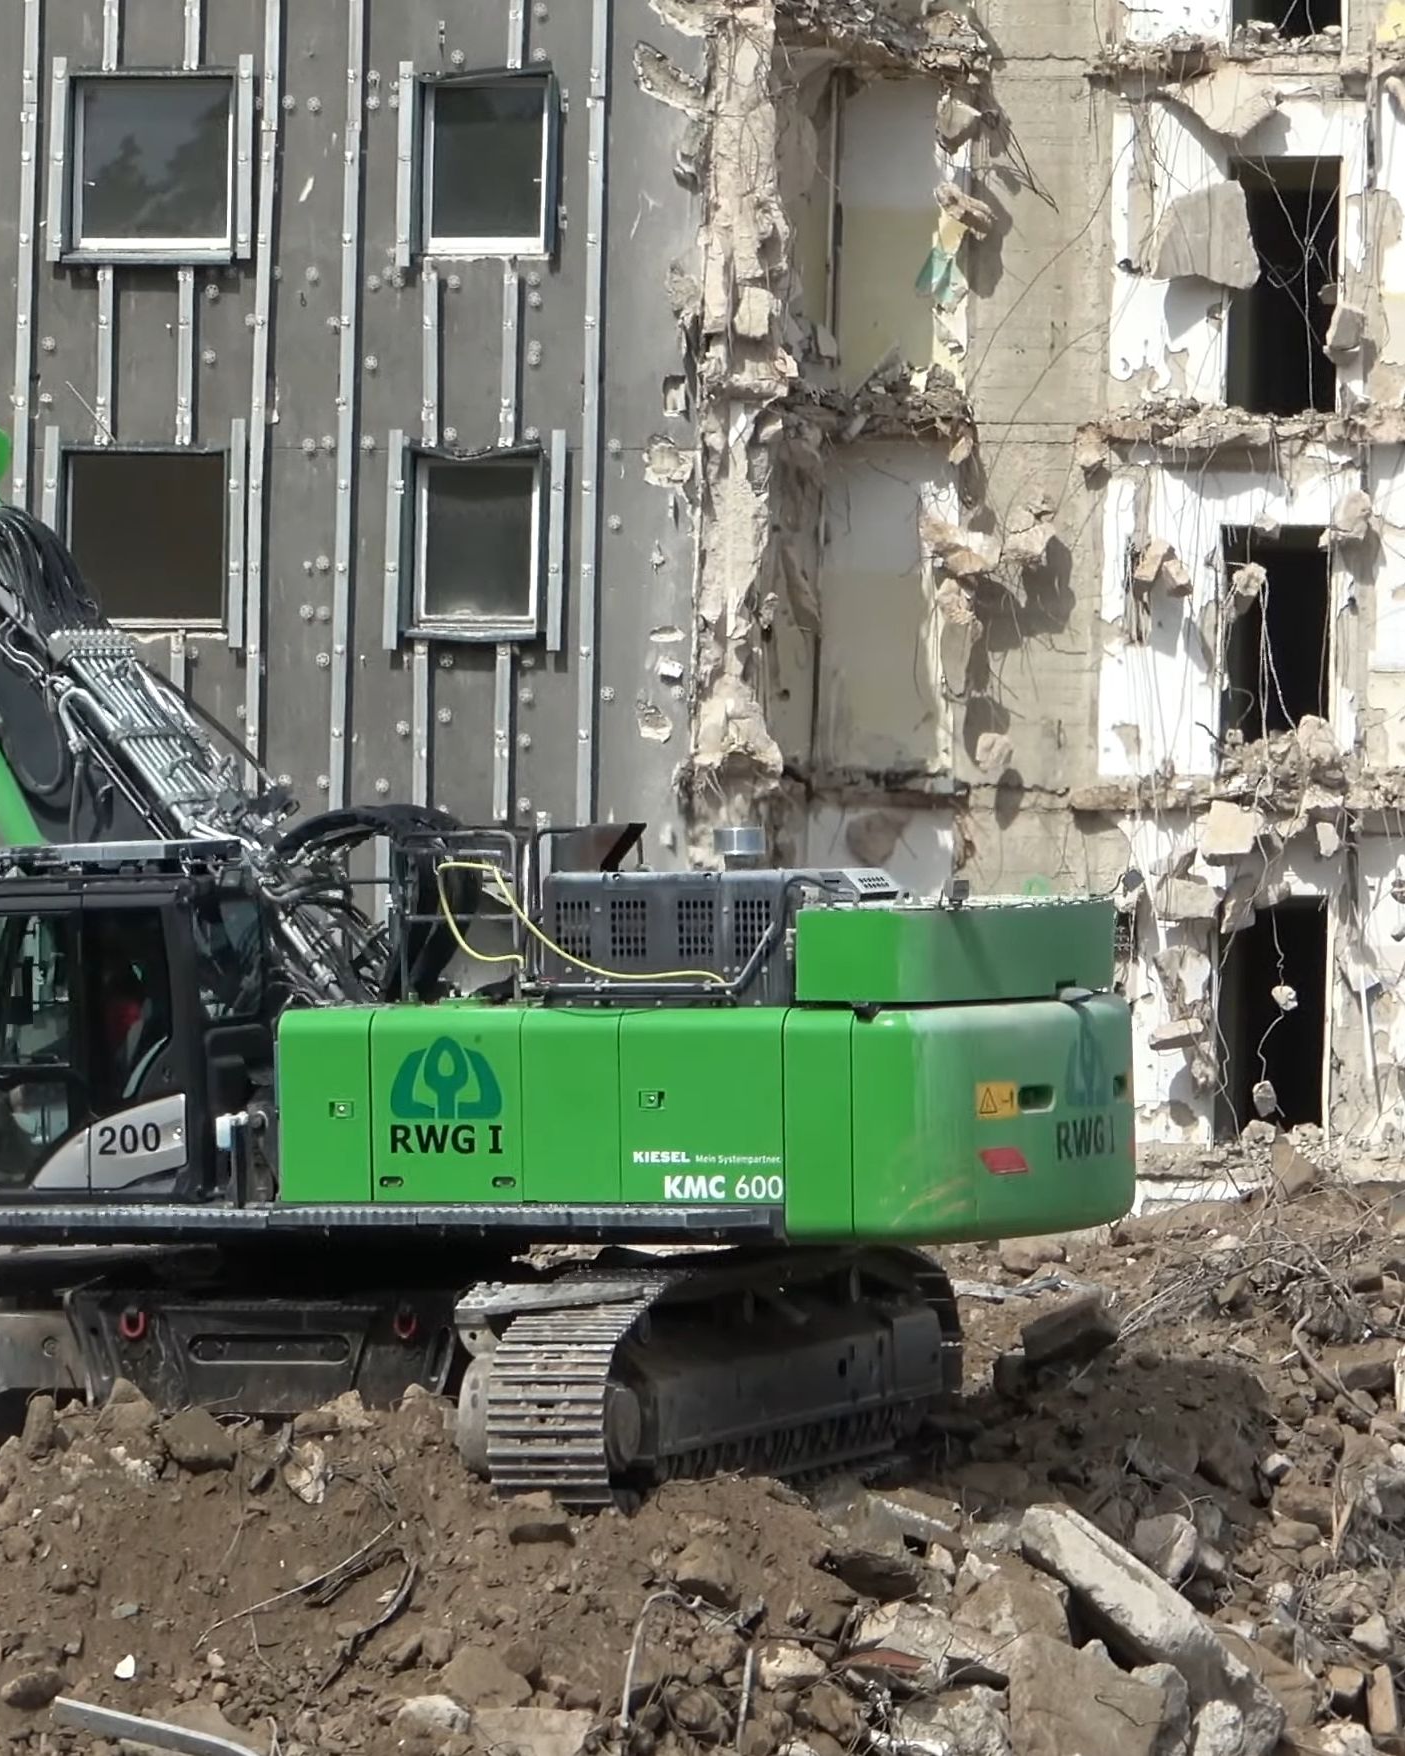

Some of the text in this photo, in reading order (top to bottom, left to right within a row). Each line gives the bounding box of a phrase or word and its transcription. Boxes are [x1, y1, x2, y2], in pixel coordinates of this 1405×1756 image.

[98, 1122, 161, 1155] 200
[390, 1124, 503, 1155] RWG I
[1057, 1115, 1105, 1161] RWG
[633, 1151, 691, 1163] KIESEL
[696, 1154, 717, 1163] Mein
[664, 1175, 784, 1199] KMC 600
